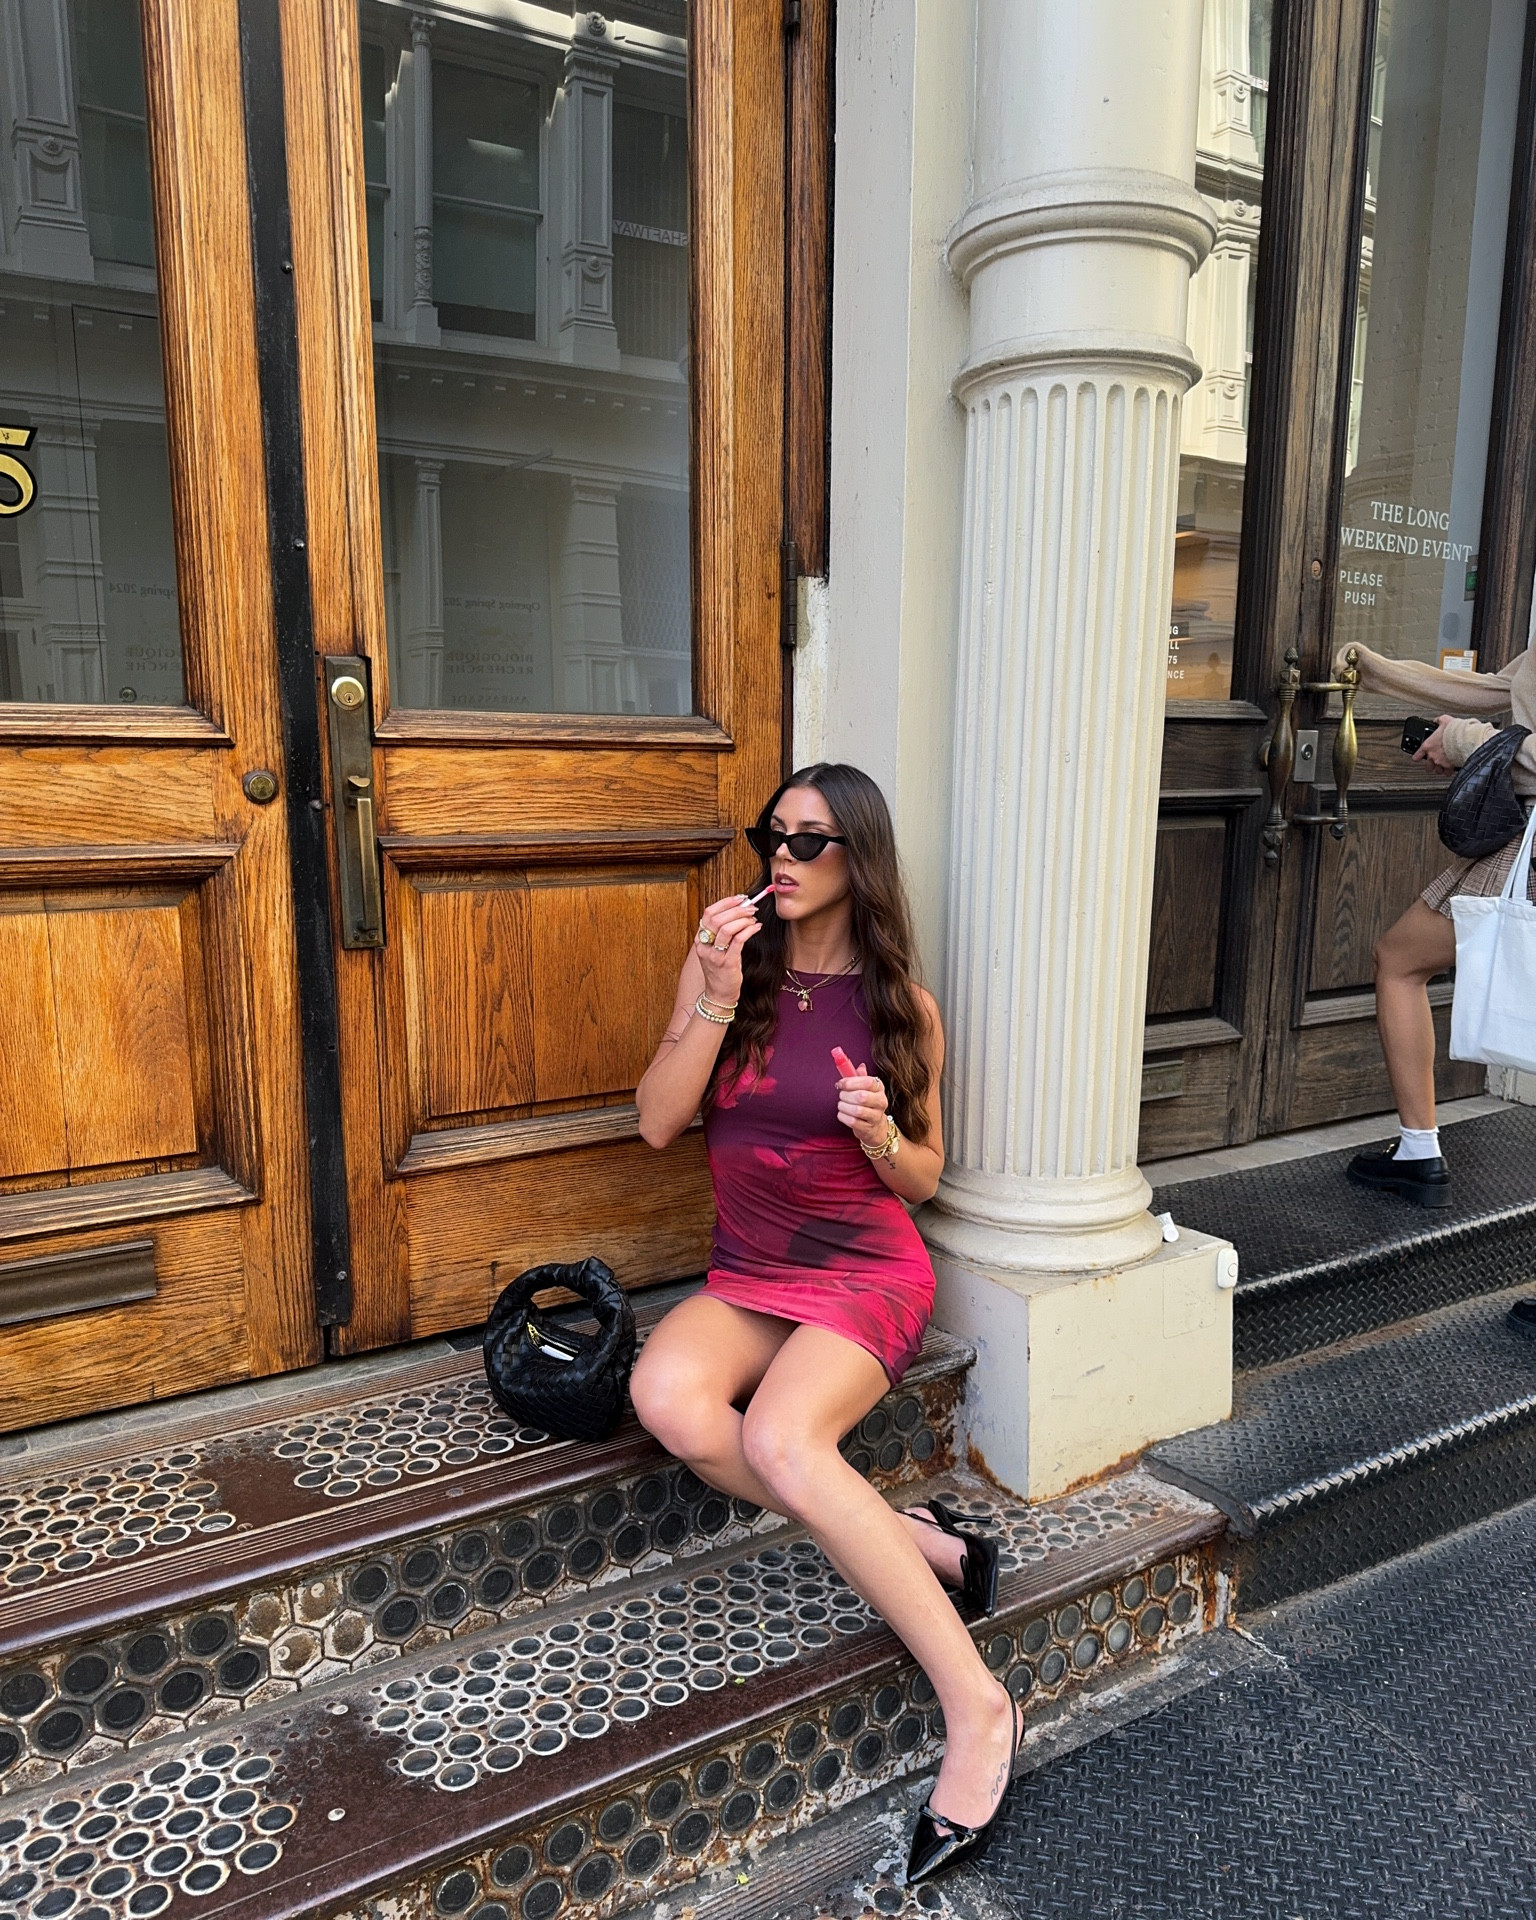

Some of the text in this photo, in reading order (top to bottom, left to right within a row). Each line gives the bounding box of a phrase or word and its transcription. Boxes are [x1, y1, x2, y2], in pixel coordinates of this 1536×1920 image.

[1370, 500, 1450, 531] THE LONG
[1340, 526, 1473, 563] WEEKEND EVENT
[1339, 569, 1384, 588] PLEASE
[1344, 590, 1376, 606] PUSH
